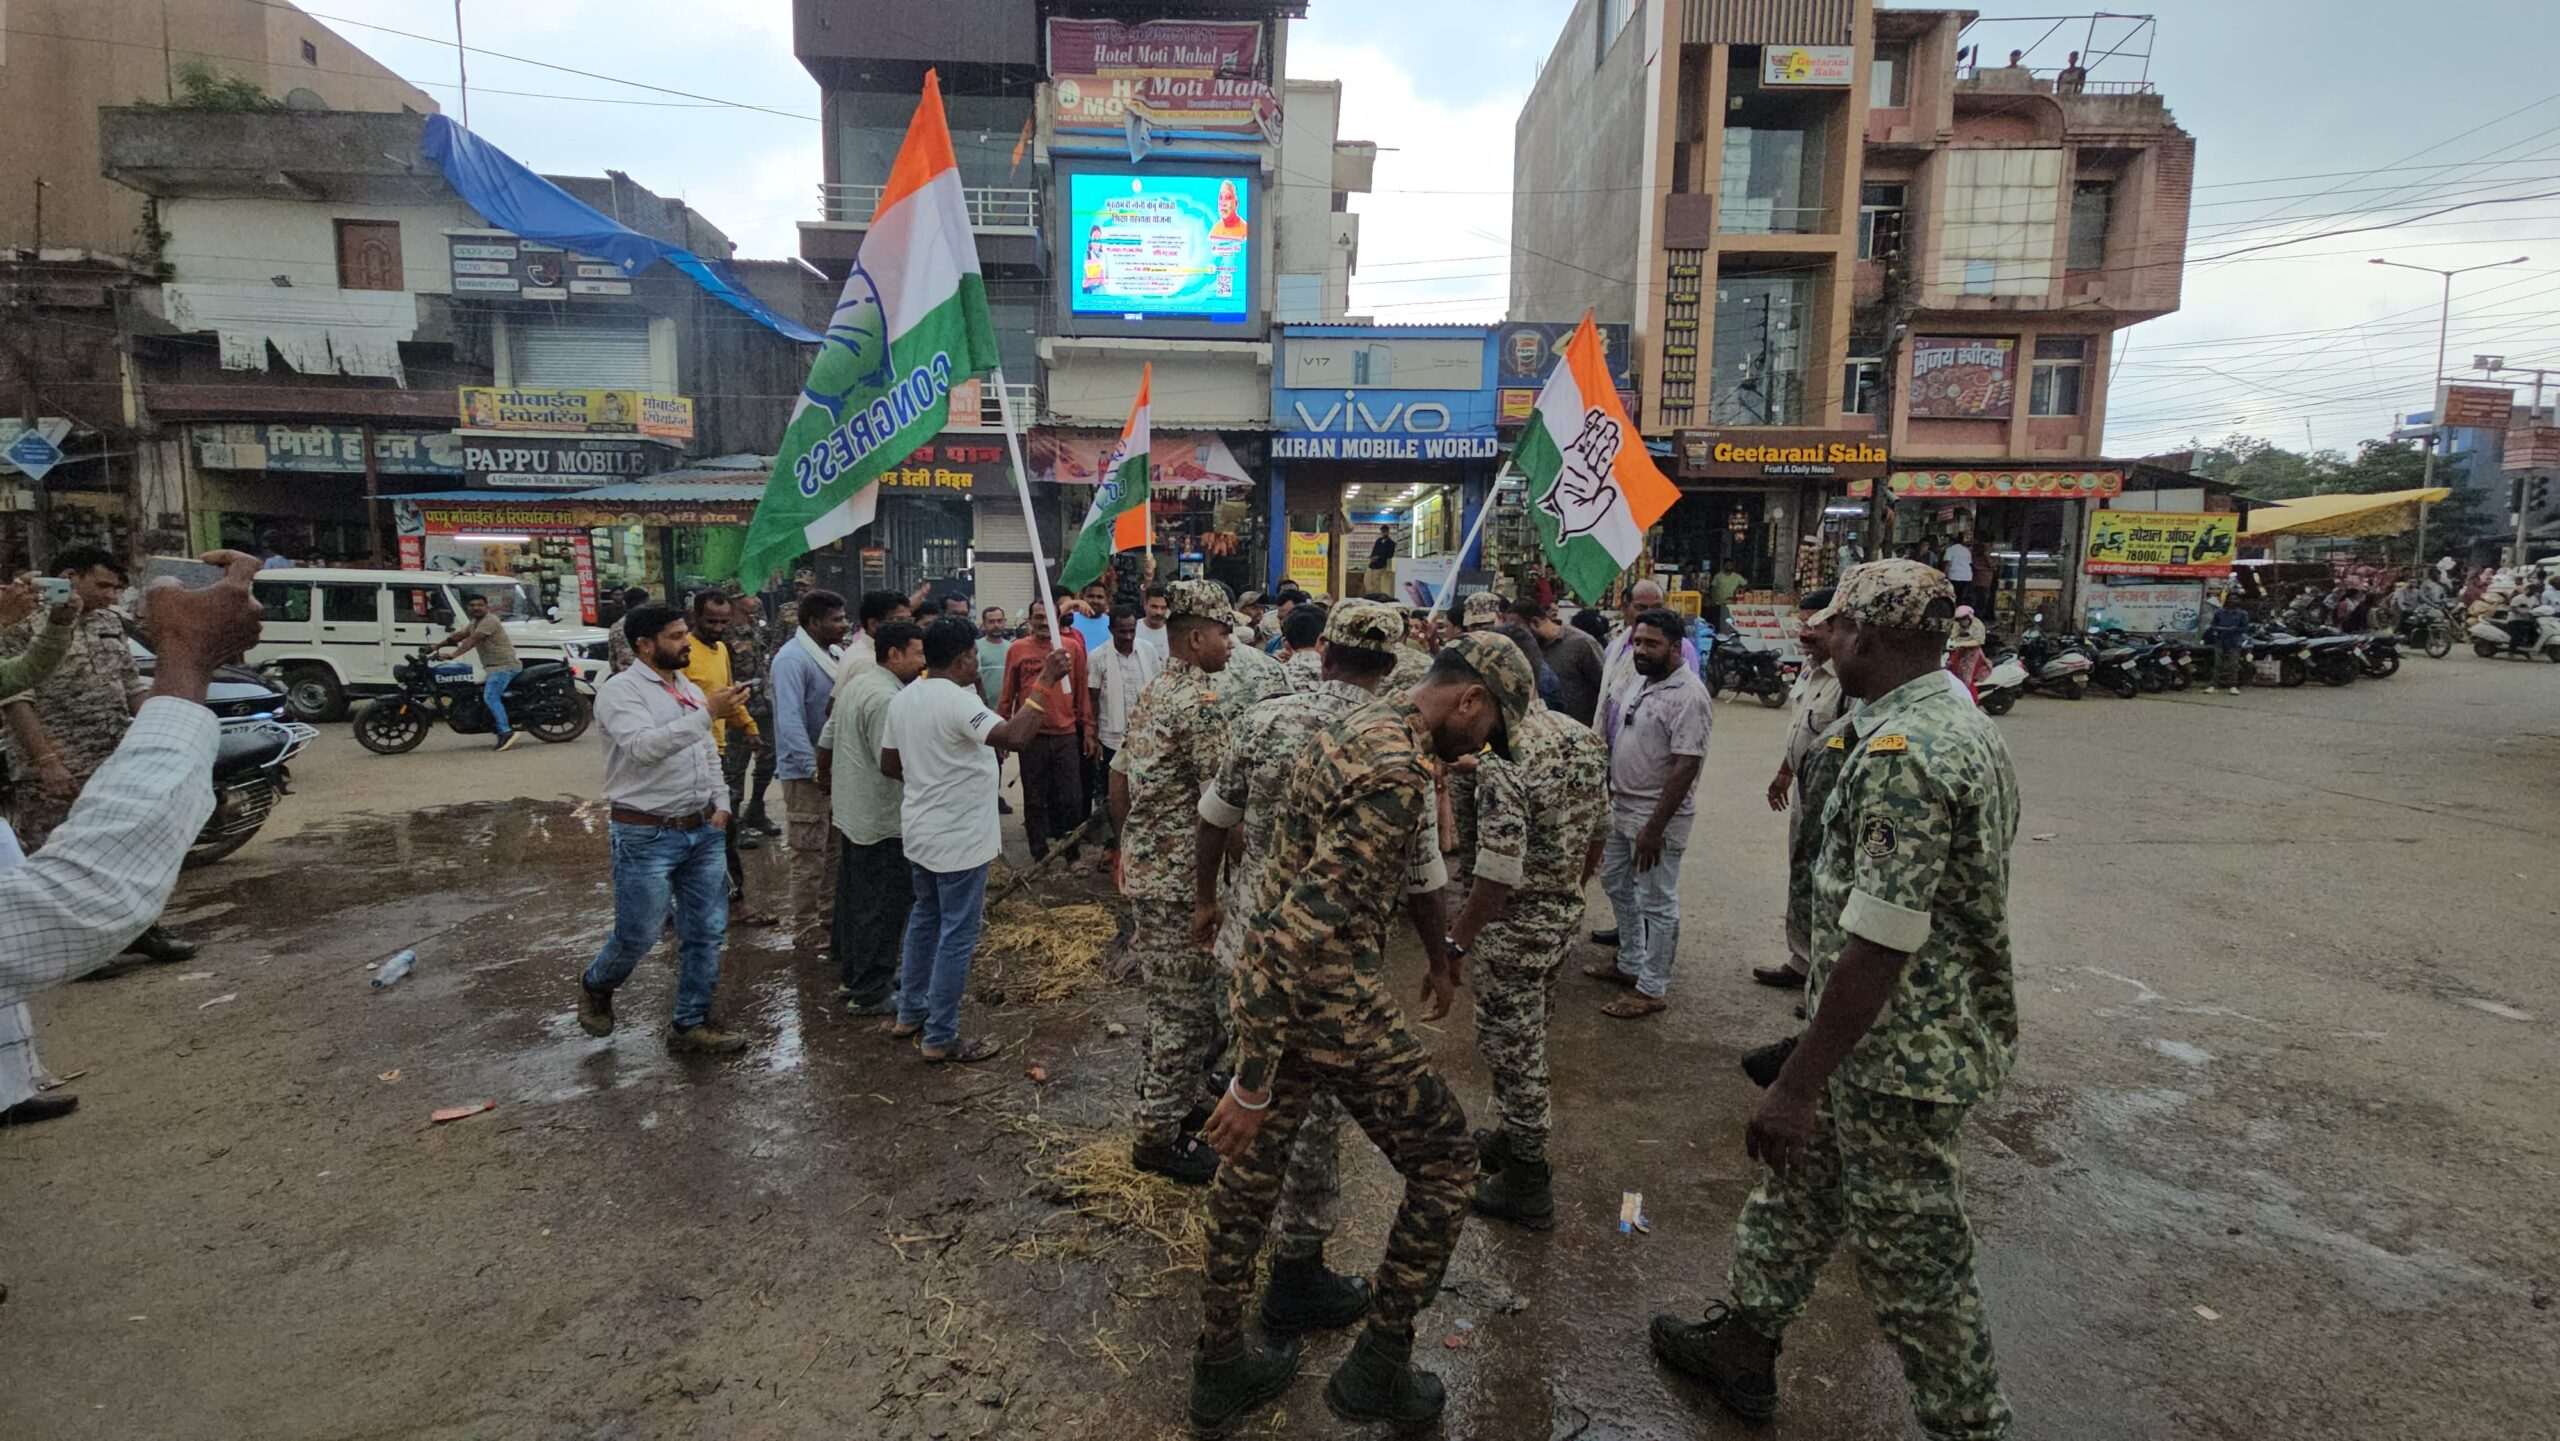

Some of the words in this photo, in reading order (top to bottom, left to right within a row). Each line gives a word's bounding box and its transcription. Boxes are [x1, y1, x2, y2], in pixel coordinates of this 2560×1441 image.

[1094, 44, 1133, 64] Hotel
[1137, 45, 1168, 64] Moti
[1173, 46, 1217, 65] Mahal
[1150, 77, 1204, 97] Moti
[1674, 265, 1697, 275] Fruit
[1673, 292, 1696, 302] Cake
[1303, 357, 1331, 366] V17
[1271, 437, 1336, 459] KIRAN
[1341, 438, 1419, 459] MOBILE
[1424, 437, 1498, 459] WORLD
[1714, 443, 1825, 463] Geetarani
[1828, 443, 1888, 463] Saha
[464, 448, 550, 472] PAPPU
[557, 451, 646, 475] MOBILE
[1764, 465, 1783, 473] Fruit
[1791, 465, 1810, 475] Daily
[1811, 465, 1835, 473] Needs
[902, 468, 930, 487] डेली
[2127, 525, 2163, 543] स्पेशल
[2165, 526, 2196, 544] ऑफर
[2125, 550, 2165, 562] 78000/-
